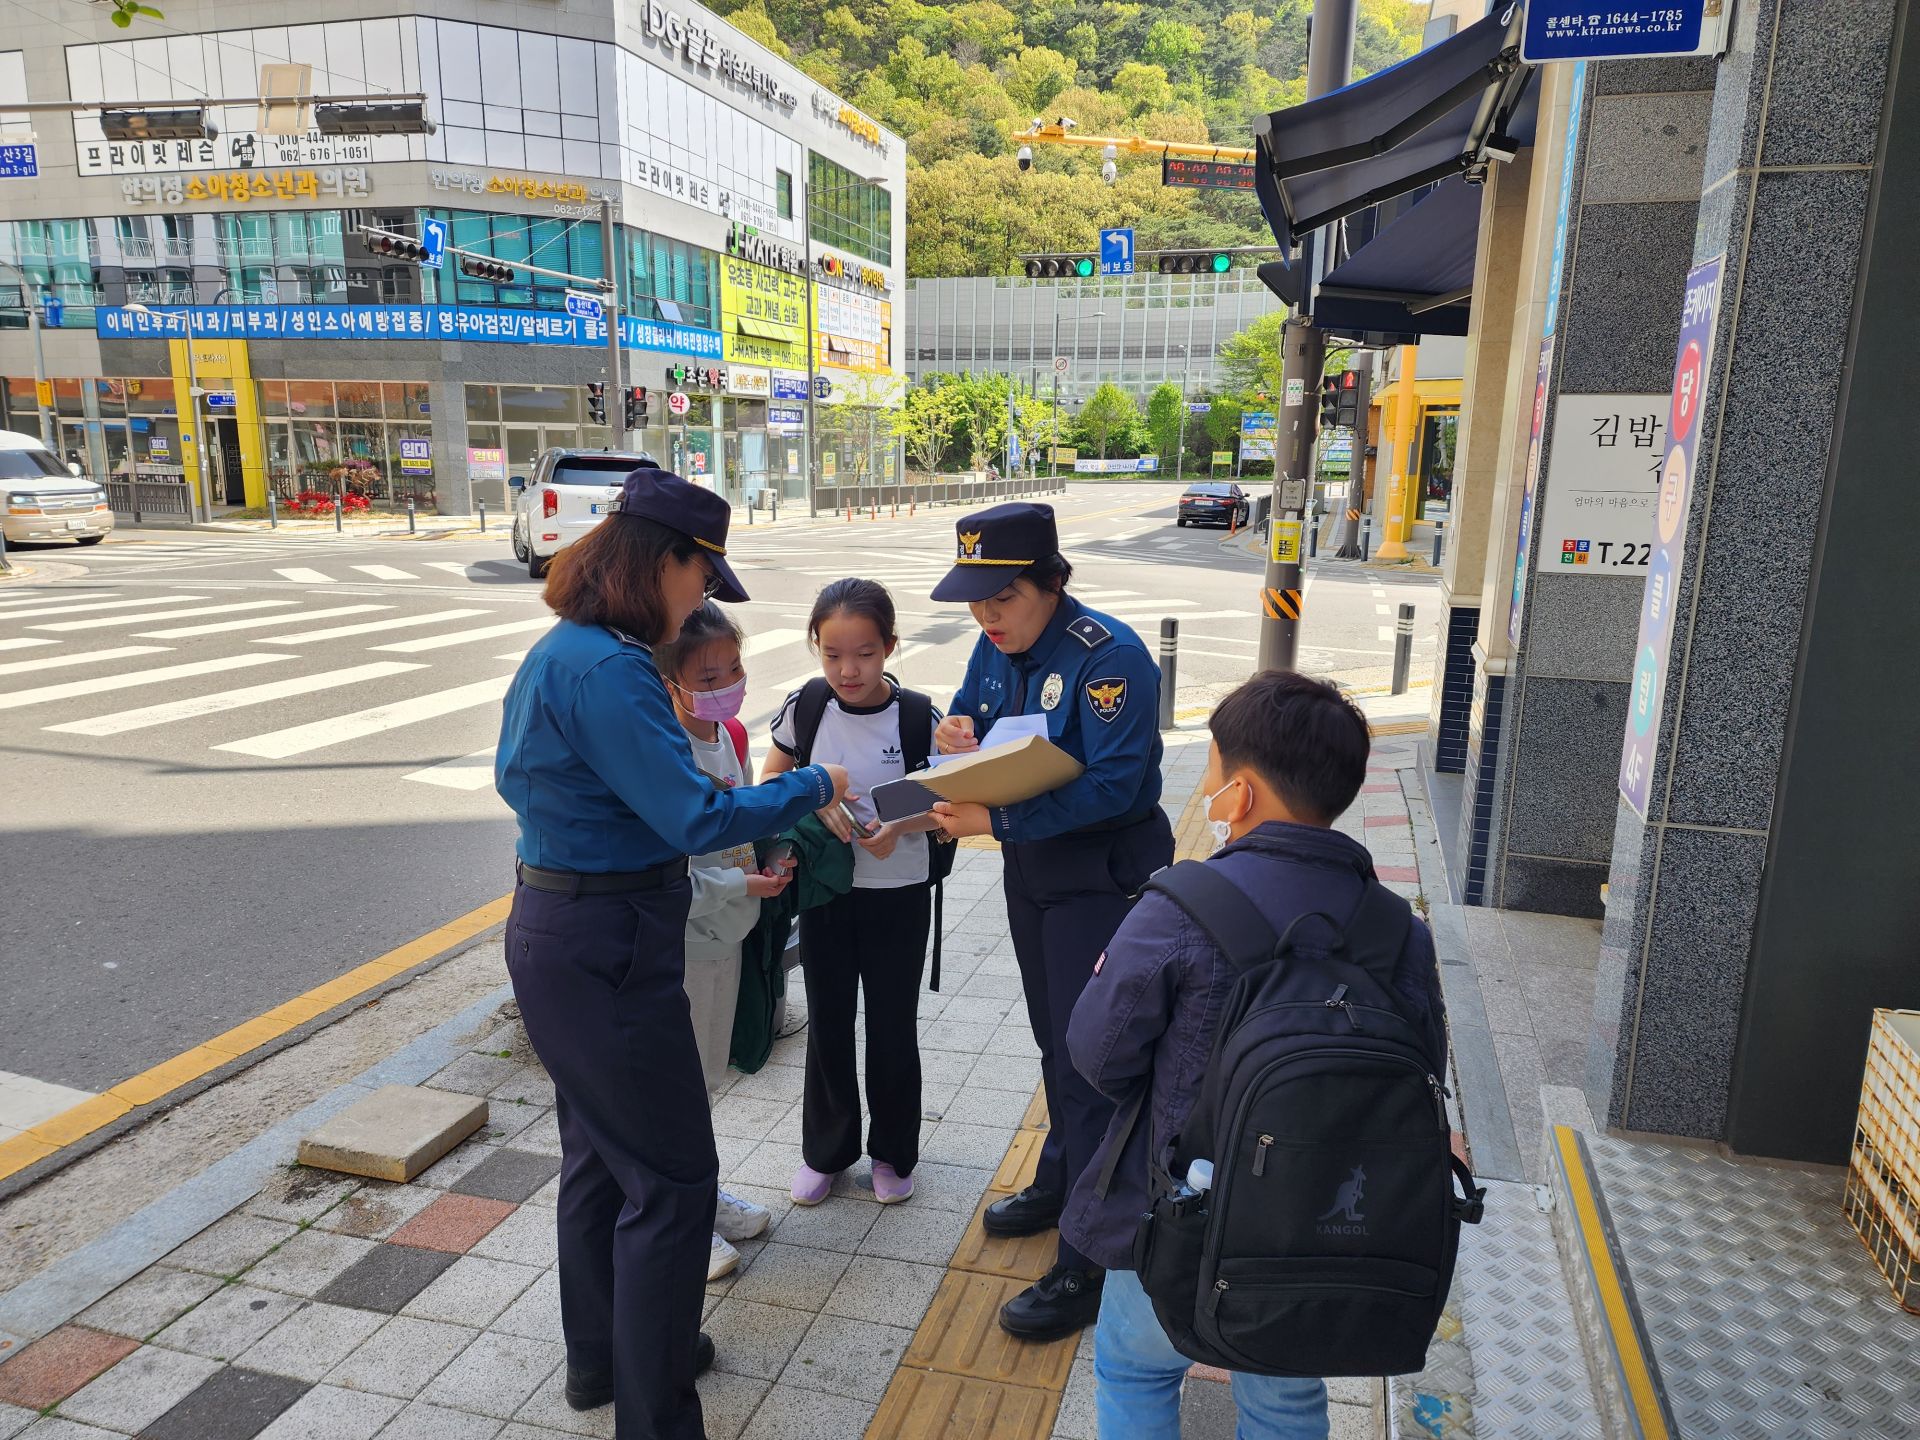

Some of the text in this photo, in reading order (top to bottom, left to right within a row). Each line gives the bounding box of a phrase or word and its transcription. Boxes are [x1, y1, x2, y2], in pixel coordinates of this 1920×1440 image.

[1545, 9, 1683, 29] 콜센타 1644-1785
[1545, 20, 1683, 39] www.ktranews.co.kr
[0, 147, 33, 163] 산3길
[88, 140, 213, 167] 프라이빗 레슨
[280, 146, 368, 162] 062-676-1051
[638, 160, 708, 205] 프라이빗 레슨
[779, 245, 799, 272] 학원
[1102, 260, 1133, 274] 비보호
[728, 264, 753, 289] 유초등
[783, 278, 797, 300] 교구
[745, 295, 762, 317] 교과
[670, 395, 685, 413] 약
[1589, 414, 1667, 448] 김밥
[151, 438, 168, 449] 임대
[402, 442, 428, 458] 임대
[473, 450, 500, 462] 임대
[1574, 496, 1649, 508] 엄마의 마음으로
[1598, 542, 1651, 567] T.22
[1626, 744, 1645, 793] 4F
[1316, 1224, 1370, 1236] KANGOL
